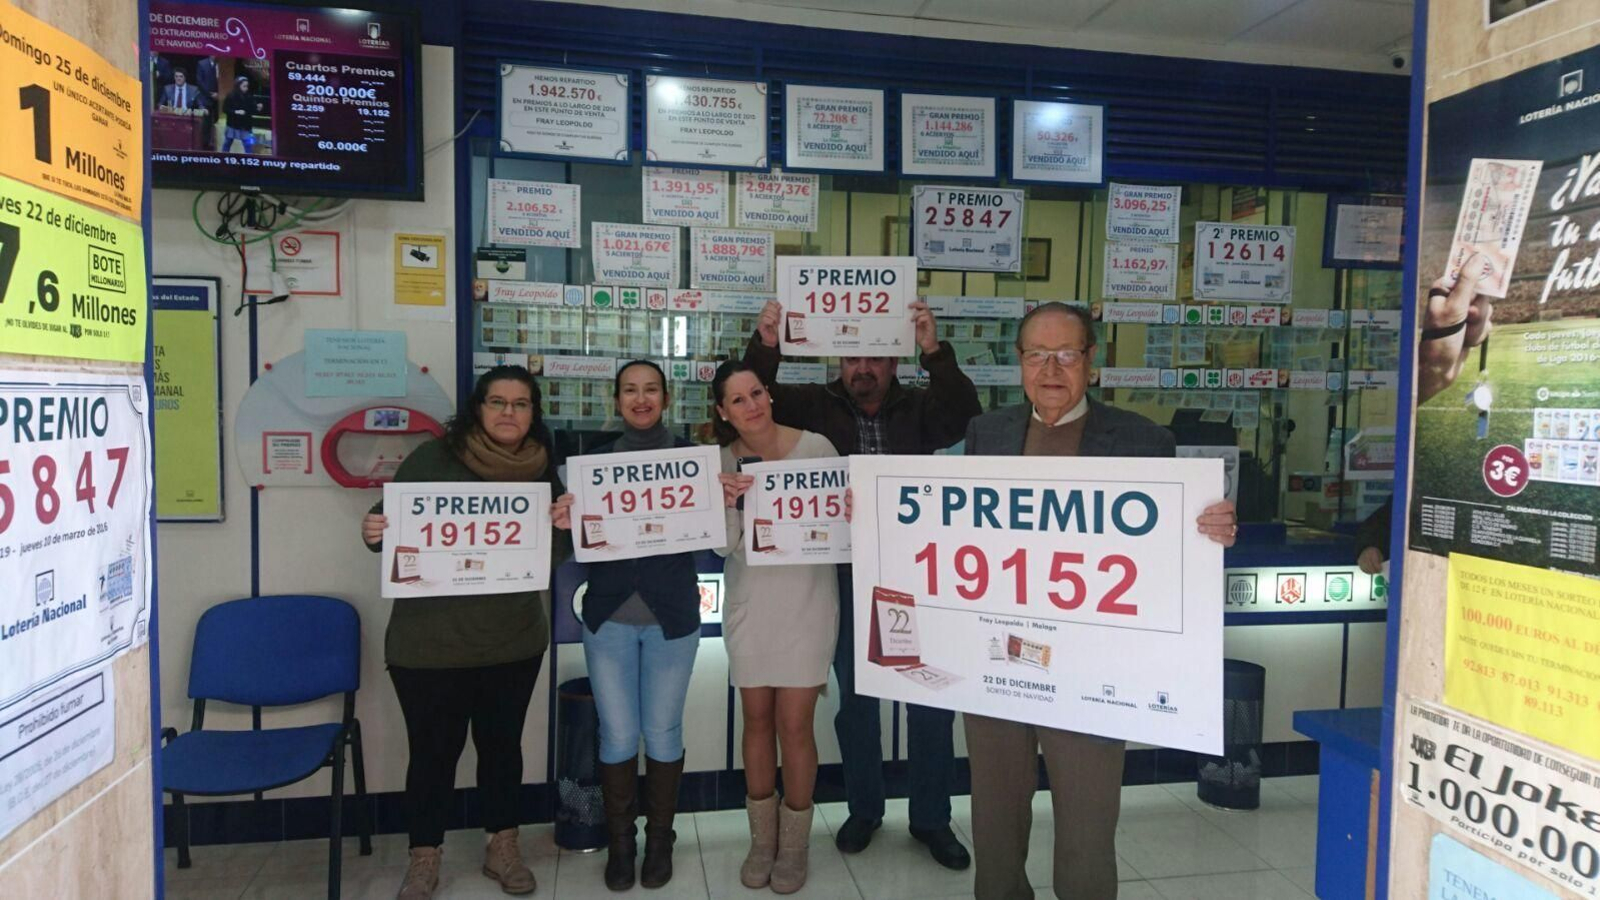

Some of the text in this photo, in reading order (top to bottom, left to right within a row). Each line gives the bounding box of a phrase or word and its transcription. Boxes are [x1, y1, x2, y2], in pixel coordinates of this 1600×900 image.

[0, 23, 131, 110] omingo 25 de diciembre
[285, 60, 395, 78] Cuartos Premios
[288, 71, 326, 83] 59.444
[306, 83, 376, 100] 200.000€
[528, 83, 596, 101] 1.942.570
[290, 102, 325, 113] 22.259
[292, 92, 390, 109] Quintos Premios
[815, 103, 868, 114] GRAN PREMIO
[357, 107, 391, 117] 19.152
[550, 107, 573, 116] PUNTO
[574, 109, 583, 117] DE
[584, 110, 606, 118] VENTA
[929, 112, 980, 121] GRAN PREMIO
[1518, 104, 1563, 125] LOTERÍA
[19, 83, 52, 165] 1
[536, 117, 594, 128] FRAY LEOPOLDO
[924, 119, 974, 132] 1.144.286
[680, 127, 735, 137] FRAY LEOPOLDO
[317, 140, 368, 153] 60.000€
[803, 141, 844, 151] VENDIDO
[845, 142, 867, 153] AQUÍ
[918, 149, 980, 160] VENDIDO AQUÍ
[65, 145, 125, 192] Millones
[180, 155, 221, 166] premio
[224, 156, 260, 167] 19.152
[262, 159, 287, 169] muy
[289, 161, 341, 172] repartido
[1027, 155, 1087, 166] VENDIDO AQUÍ
[757, 174, 811, 184] GRAN PREMIO
[516, 186, 553, 196] PREMIO
[651, 180, 715, 196] 1.391,95
[745, 181, 811, 197] 2.947,37€
[1124, 191, 1172, 200] GRAN PREMIO
[505, 201, 557, 214] 2.106,52
[1113, 197, 1167, 213] 3.096,25
[652, 207, 720, 220] VENDIDO AQUÍ
[744, 211, 809, 224] VENDIDO AQUÍ
[925, 206, 1012, 229] 25847
[26, 200, 43, 222] 22
[46, 207, 62, 228] de
[64, 214, 117, 245] diciembre
[498, 227, 571, 240] VENDIDO AQUÍ
[614, 230, 671, 240] GRAN PREMIO
[1112, 226, 1170, 237] VENDIDO AQUÍ
[1230, 228, 1280, 243] PREMIO
[1550, 215, 1581, 248] tu
[602, 238, 671, 253] 1.021,67€
[712, 236, 766, 245] GRAN PREMIO
[700, 243, 766, 257] 1.888,79€
[1129, 246, 1154, 254] PREMIO
[1208, 241, 1286, 262] 12614
[92, 253, 122, 276] BOTE
[1112, 257, 1166, 272] 1.162,97
[91, 274, 124, 289] MILLONARIO
[602, 269, 671, 280] VENDIDO AQUÍ
[700, 273, 765, 285] VENDIDO AQUÍ
[817, 268, 897, 286] PREMIO
[494, 286, 559, 300] Fray Leopoldo
[1111, 283, 1168, 294] VENDIDO AQUÍ
[72, 293, 137, 327] Millones
[805, 290, 891, 314] 19152
[1107, 307, 1159, 319] Fray Leopoldo
[550, 360, 611, 375] Fray Leopoldo
[1105, 371, 1156, 384] Fray Leopoldo
[613, 460, 700, 484] PREMIO
[783, 470, 849, 490] PREMI
[1489, 459, 1522, 487] 3€
[435, 496, 530, 515] PREMIO
[602, 484, 696, 515] 19152
[772, 494, 842, 520] 1915
[897, 483, 1159, 537] 5º PREMIO
[420, 520, 522, 548] 19152
[914, 541, 1138, 617] 19152
[1458, 570, 1596, 606] TODOS LOS MESES UN SORTEO
[1459, 581, 1471, 591] DE
[1471, 584, 1481, 594] 12
[1490, 587, 1503, 598] EN
[1504, 589, 1545, 607] LOTERÍA
[1, 593, 87, 641] Lotería Nacional
[887, 607, 913, 635] 22
[1460, 606, 1513, 632] 100.000
[1515, 623, 1561, 644] EUROS
[1562, 636, 1579, 650] AL
[983, 675, 1057, 694] 22 DE DICIEMBRE
[1501, 671, 1541, 692] 87.013
[1547, 685, 1590, 708] 91.313
[986, 686, 1055, 703] SORTEO DE NAVIDAD
[1081, 695, 1138, 709] LOTERÍA NACIONAL
[1148, 702, 1178, 712] LOTERÍAS
[1523, 695, 1564, 718] 89.113
[17, 692, 85, 739] Prohibido fumar
[1444, 743, 1484, 780] El
[1407, 760, 1600, 880] 1.000.00
